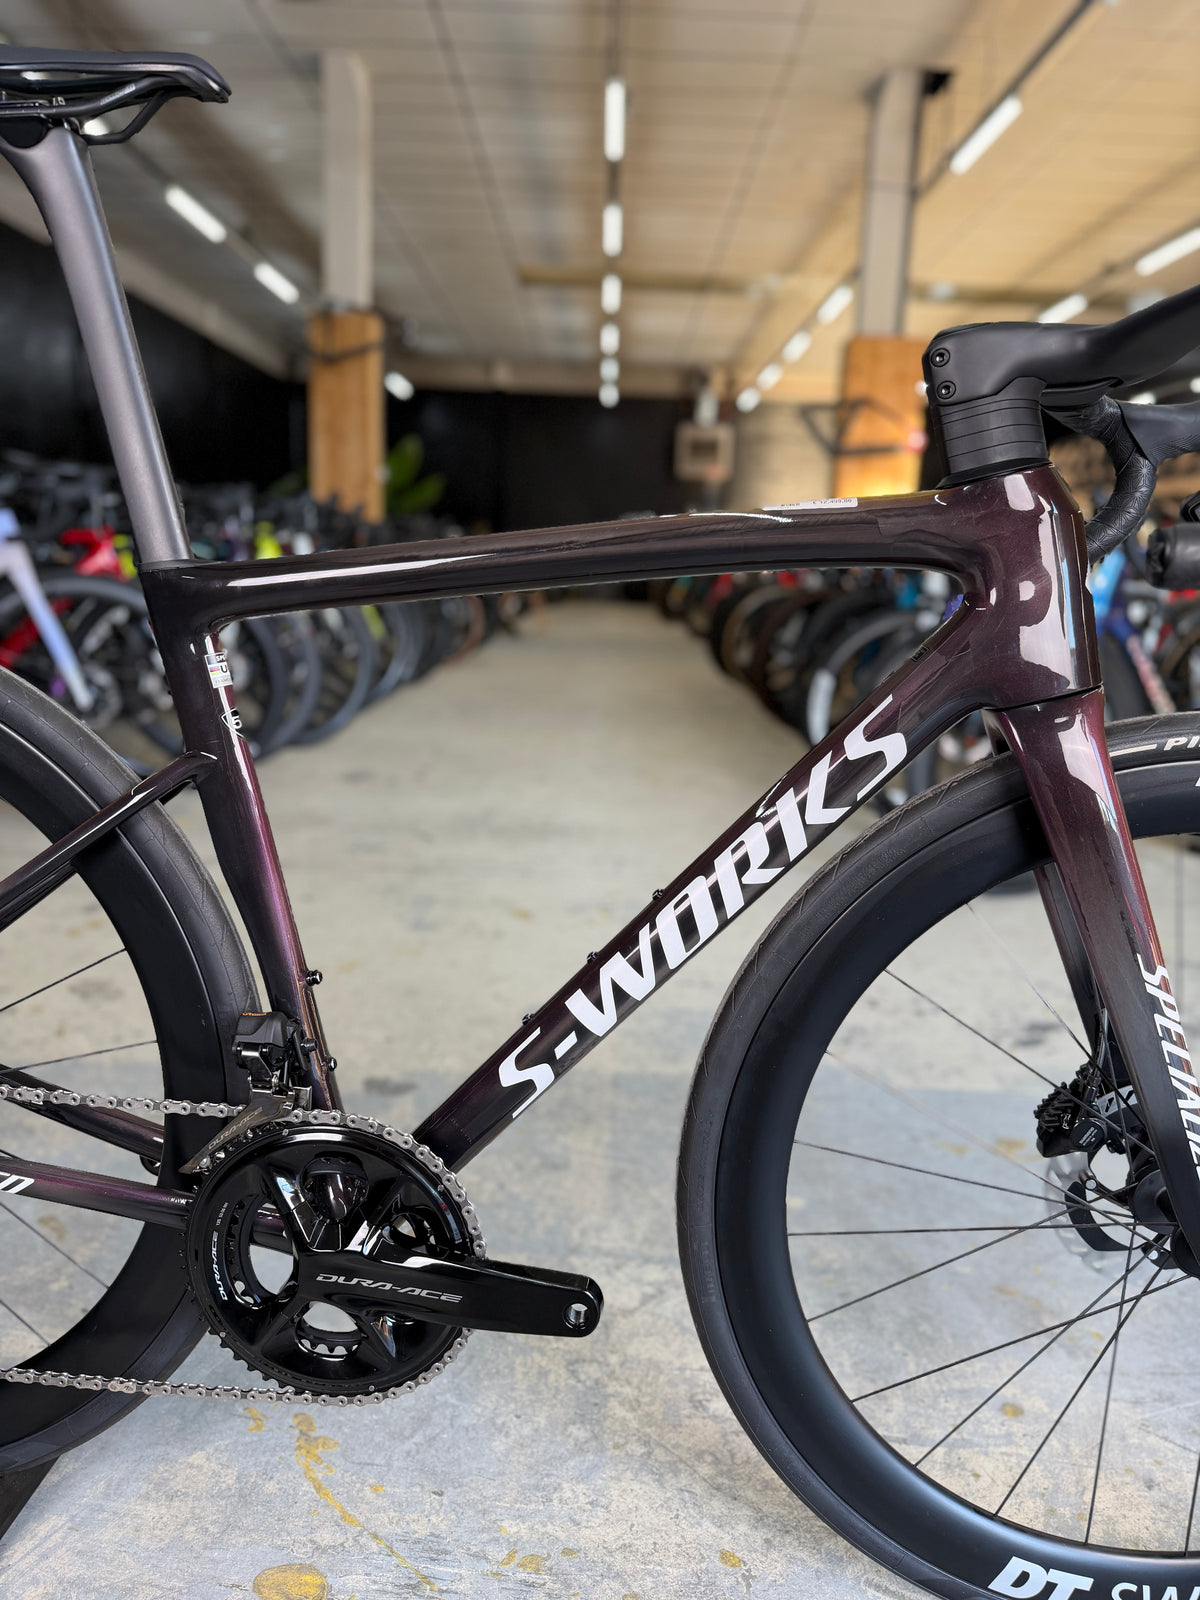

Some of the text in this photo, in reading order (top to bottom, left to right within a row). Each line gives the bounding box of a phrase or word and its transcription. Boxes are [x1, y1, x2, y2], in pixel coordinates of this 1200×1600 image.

[1163, 735, 1200, 751] PI
[498, 694, 908, 1119] S-WORKS
[211, 1230, 229, 1301] DURA-ACE
[316, 1273, 463, 1303] DURA-ACE
[987, 1555, 1095, 1600] DT
